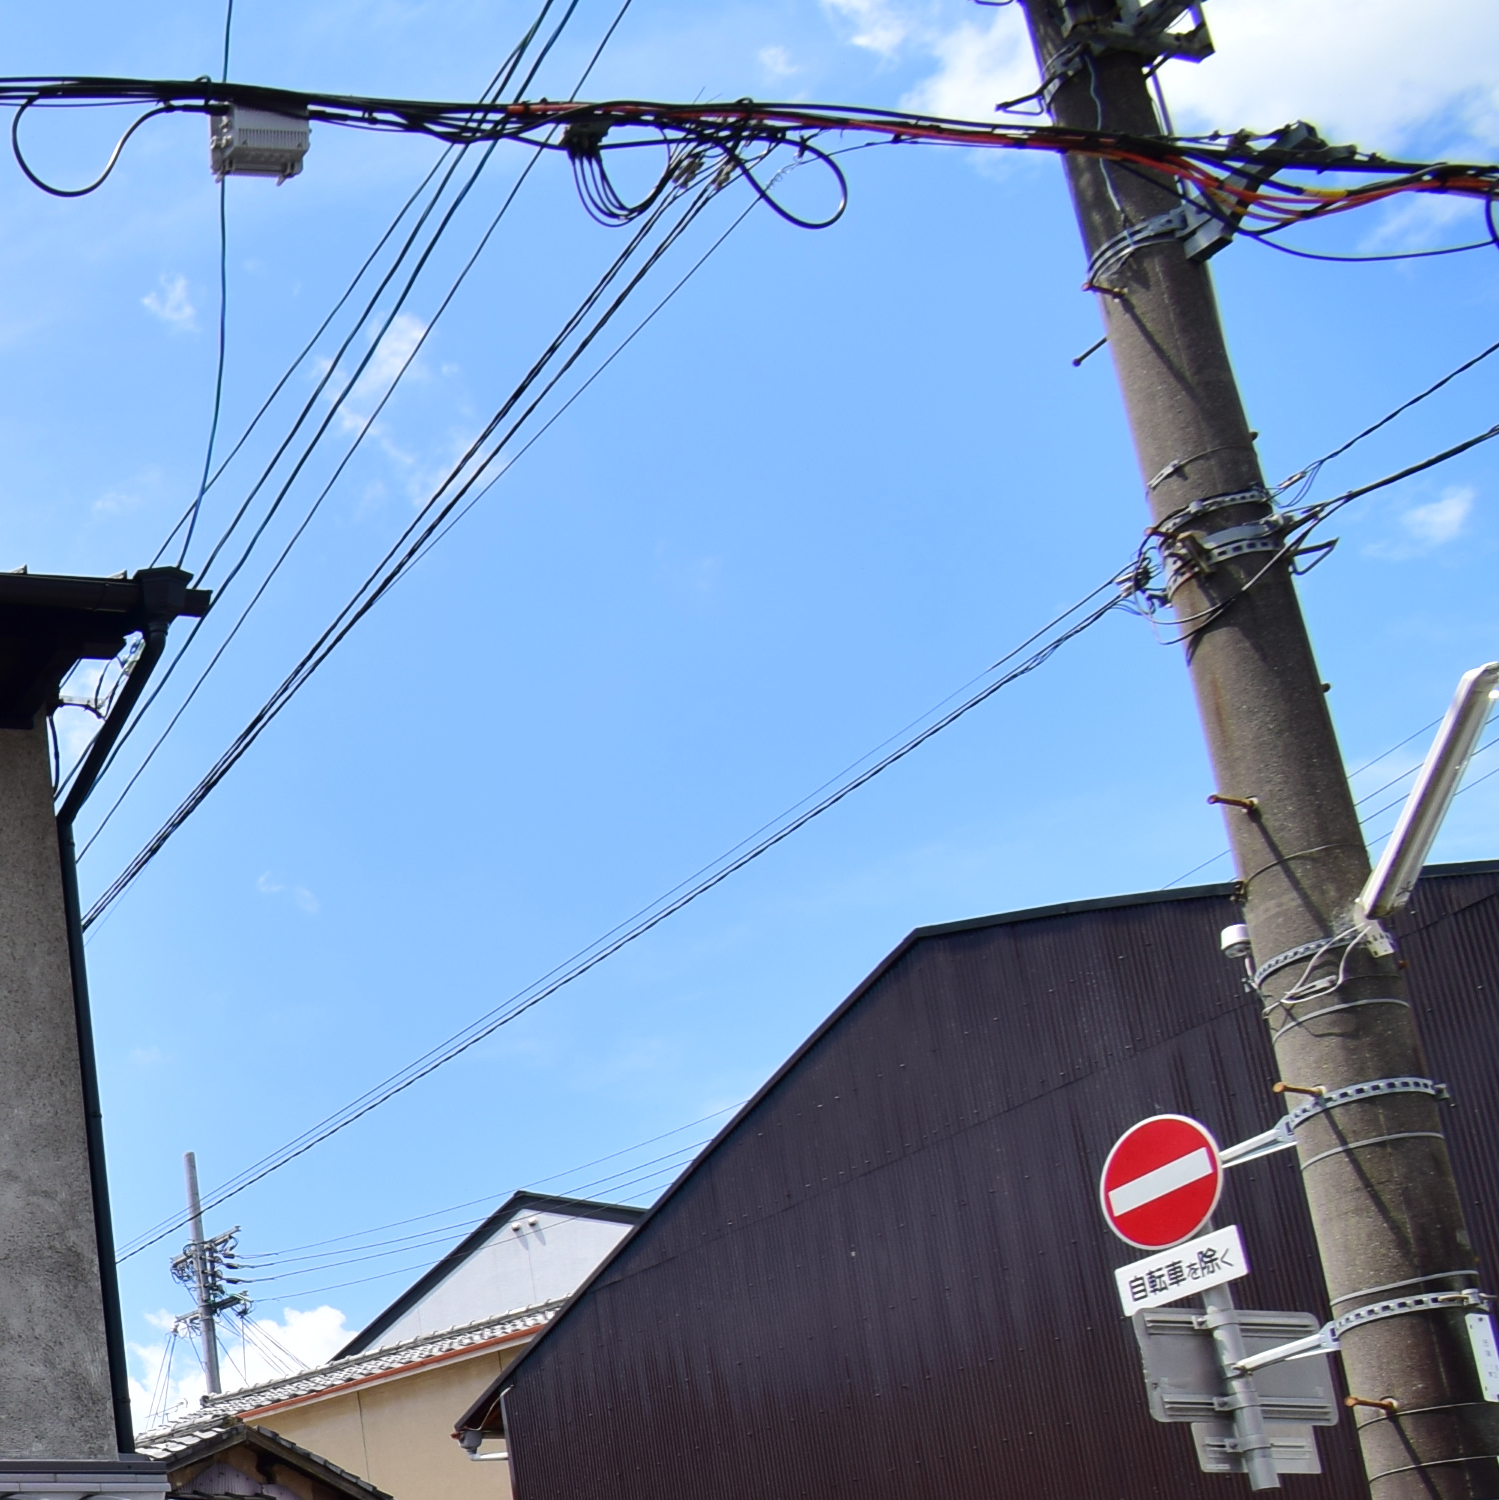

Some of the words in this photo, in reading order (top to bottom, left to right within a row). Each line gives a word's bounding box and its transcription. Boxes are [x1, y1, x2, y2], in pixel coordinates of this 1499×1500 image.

[1128, 1247, 1234, 1302] 自転車を除く
